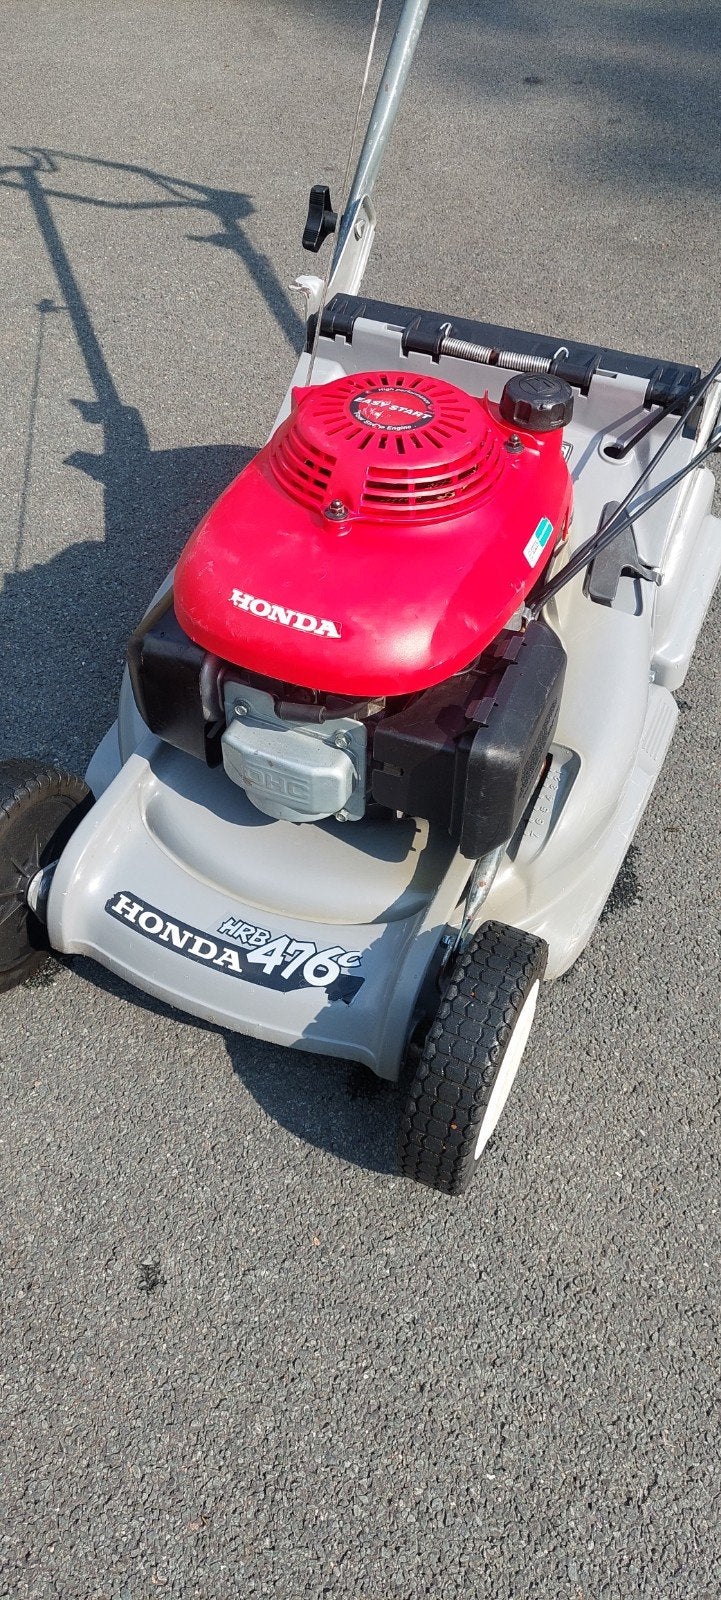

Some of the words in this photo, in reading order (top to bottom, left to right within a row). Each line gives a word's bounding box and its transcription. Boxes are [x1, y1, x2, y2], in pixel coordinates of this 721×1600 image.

[353, 397, 391, 407] EASY
[389, 405, 433, 419] START
[228, 588, 342, 638] HONDA
[111, 893, 242, 973] HONDA
[217, 917, 272, 946] HRB
